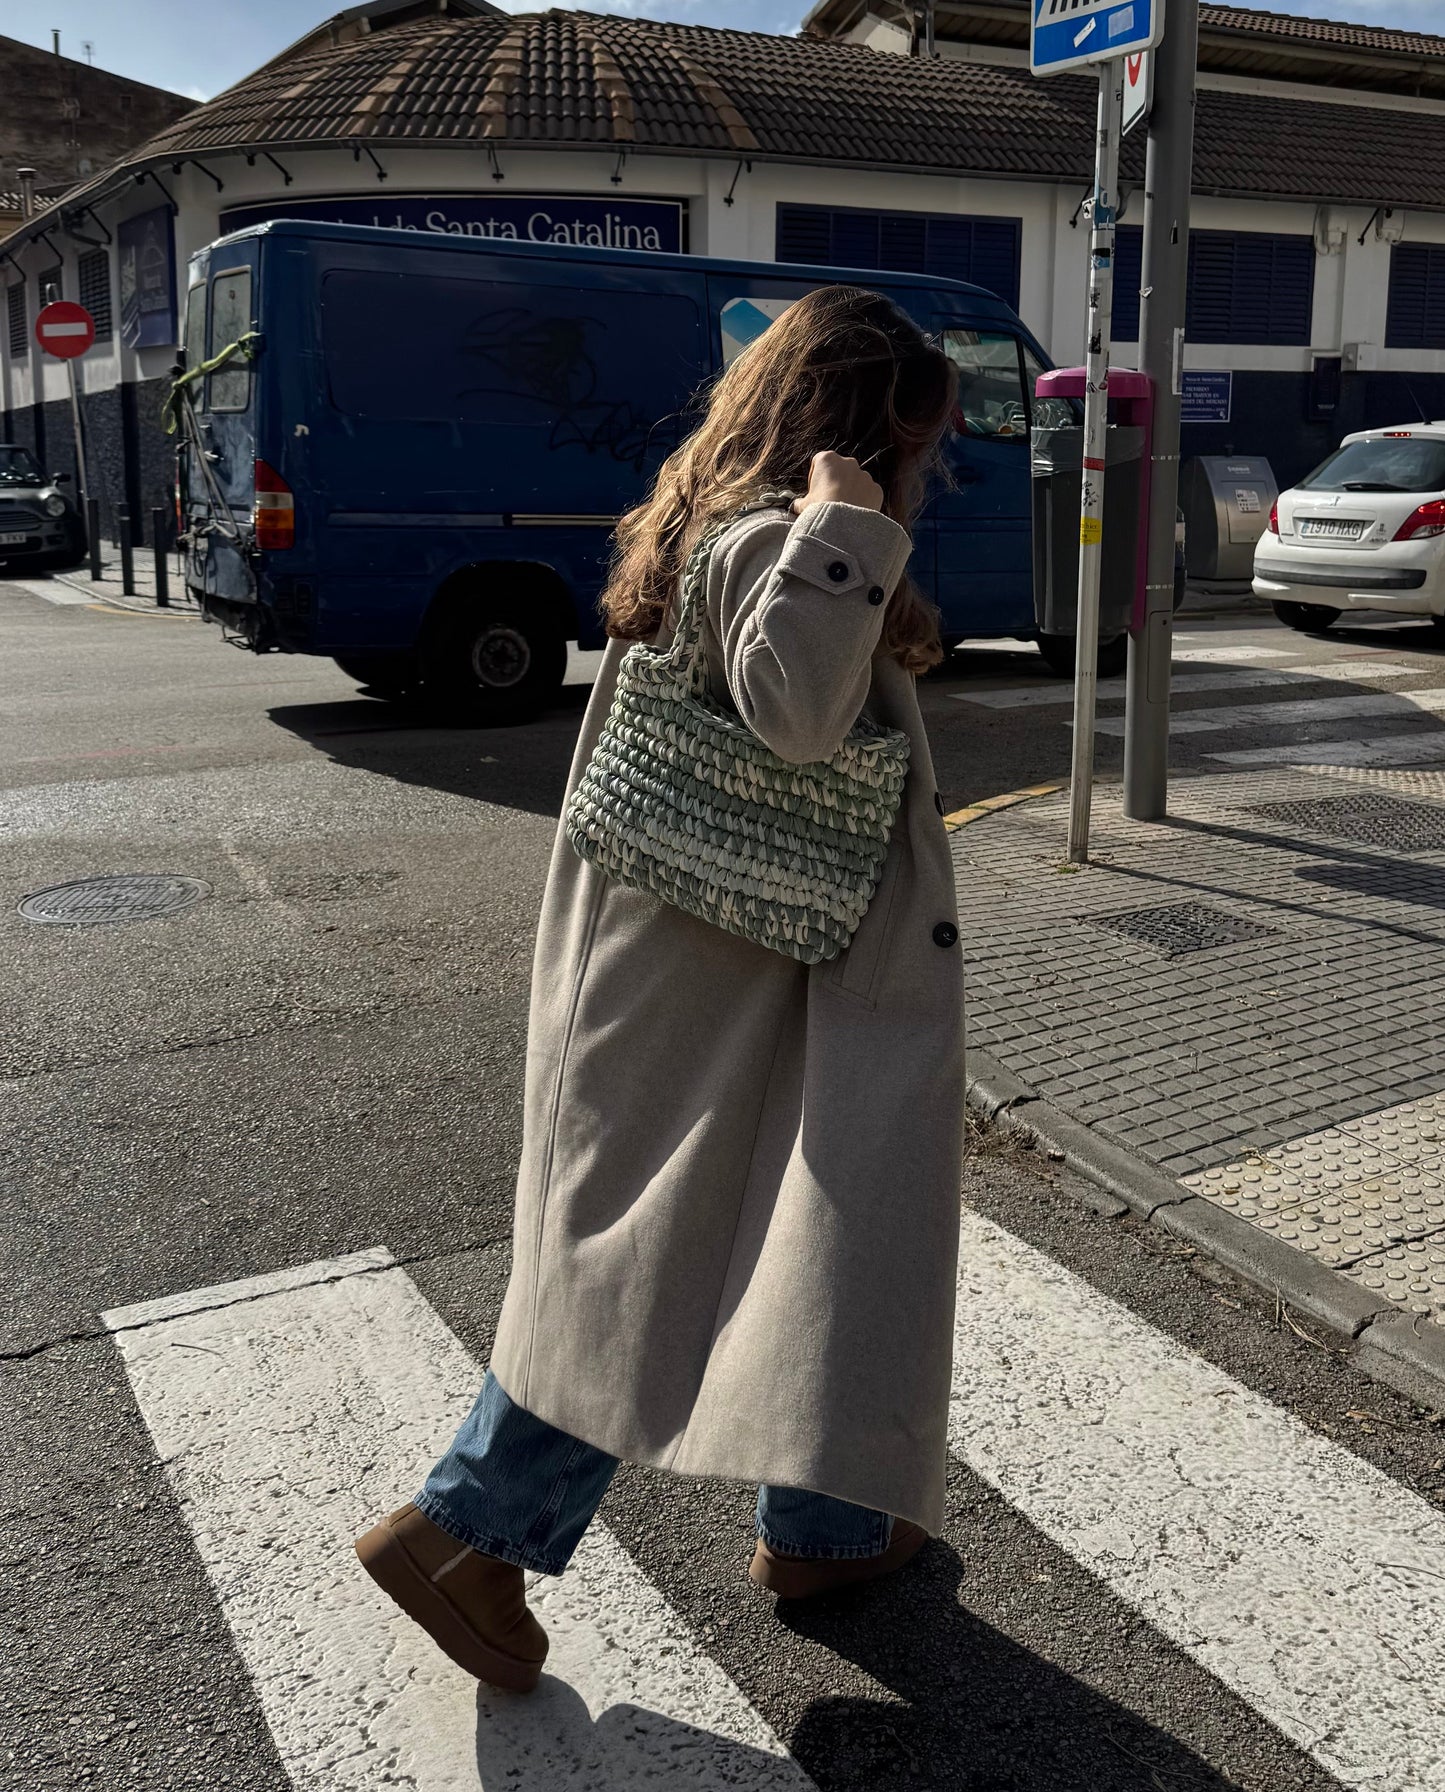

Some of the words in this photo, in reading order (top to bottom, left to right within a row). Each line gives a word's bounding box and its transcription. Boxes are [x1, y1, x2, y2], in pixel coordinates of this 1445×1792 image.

[426, 211, 518, 240] Santa
[527, 212, 662, 250] Catalina
[1309, 520, 1336, 534] 1910
